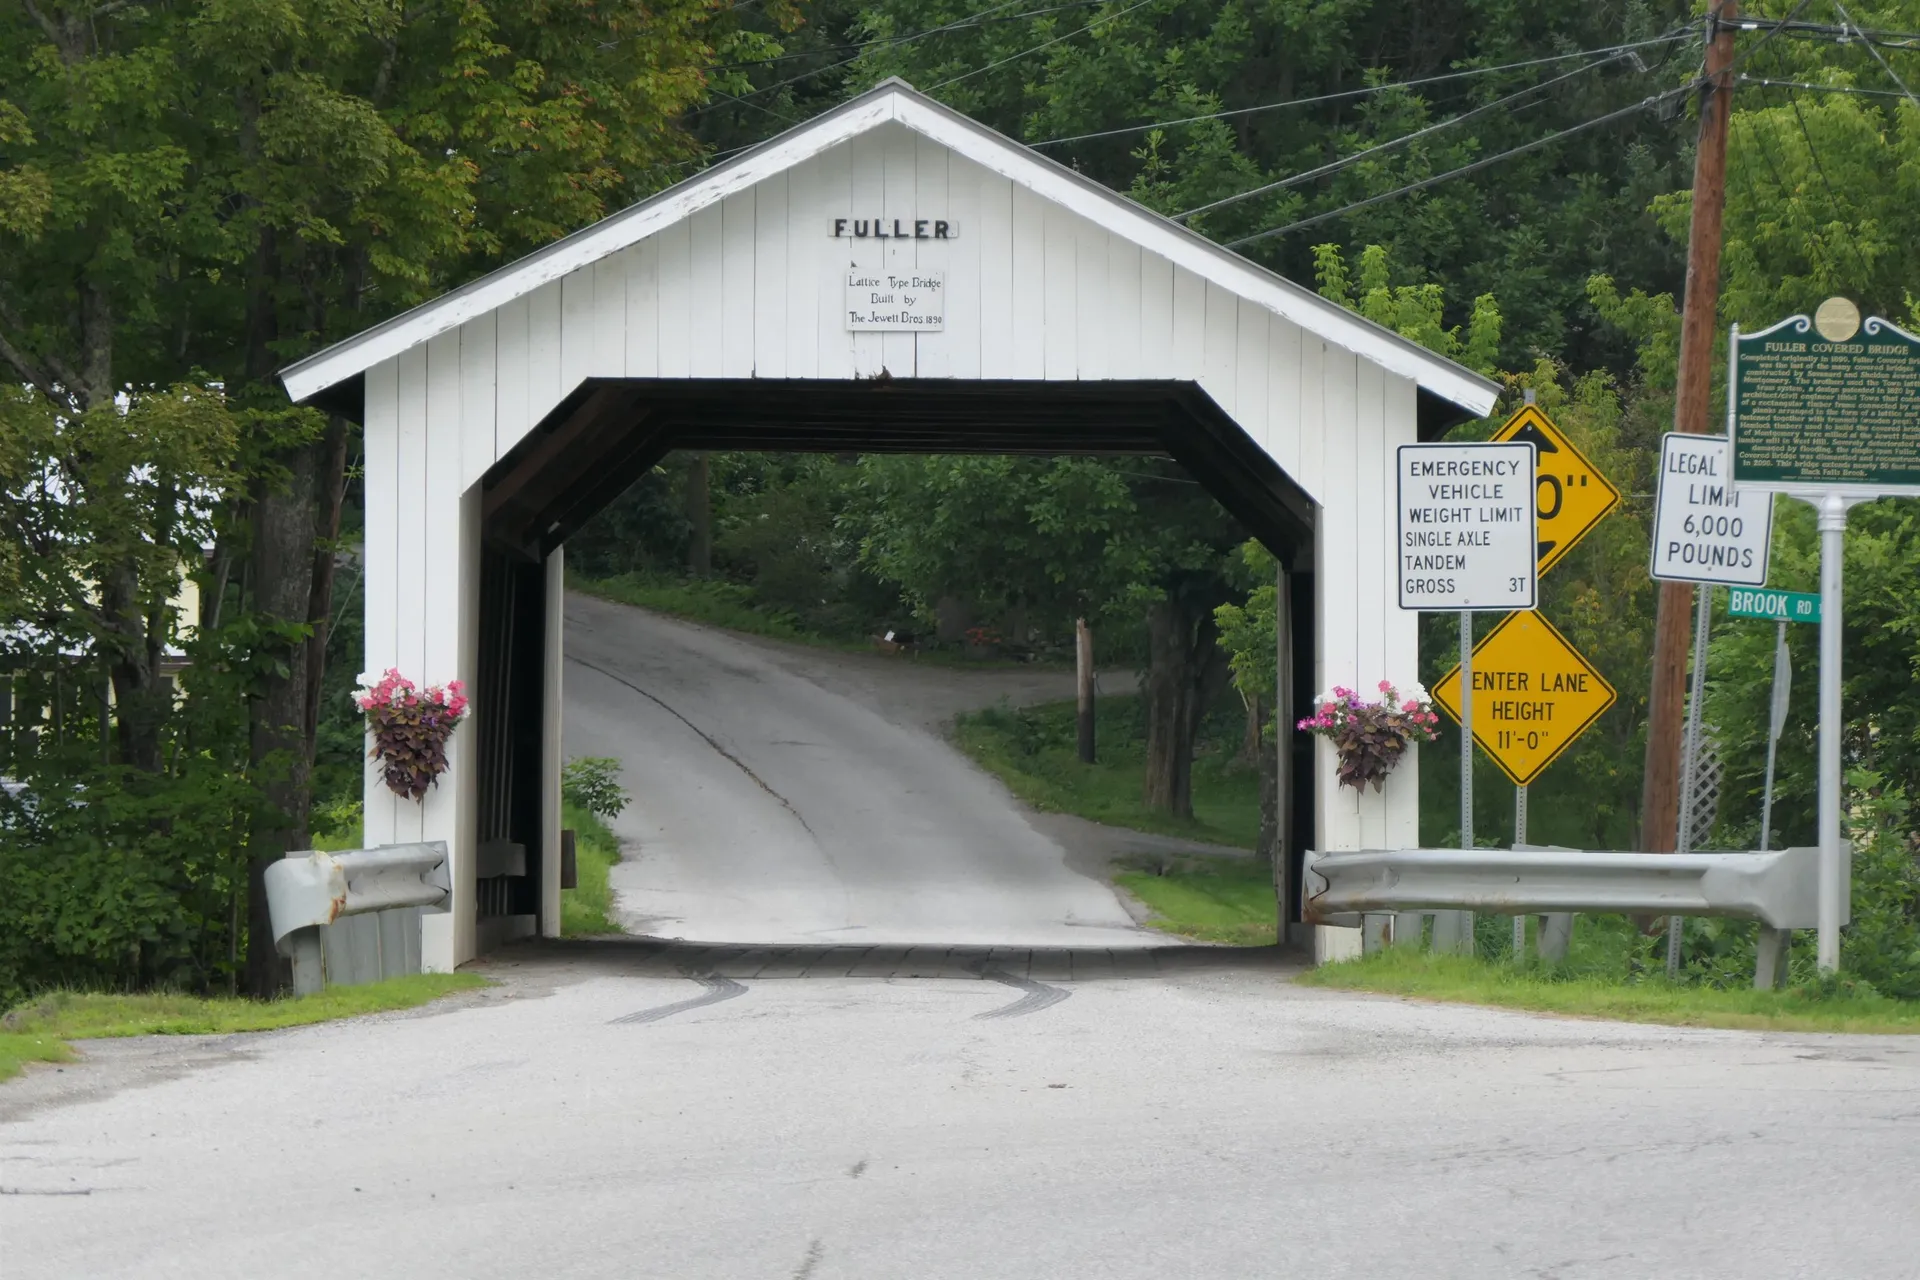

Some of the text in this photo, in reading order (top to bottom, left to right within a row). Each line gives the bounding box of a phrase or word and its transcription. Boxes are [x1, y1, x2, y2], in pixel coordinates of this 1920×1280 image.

[835, 218, 949, 238] FULLER
[848, 276, 941, 292] Lattice Type Bridge
[871, 293, 916, 306] Built by
[849, 312, 865, 323] The
[868, 312, 898, 323] Jewett
[926, 316, 942, 324] 1890
[1765, 342, 1909, 355] FULLER COVERED BRIDGE
[1410, 460, 1520, 476] EMERGENCY
[1669, 452, 1717, 476] LEGAL
[1429, 484, 1504, 500] VEHICLE
[1410, 507, 1522, 523] WEIGHT LIMIT
[1684, 514, 1743, 538] 6,000
[1406, 531, 1490, 547] SINGLE AXLE
[1405, 556, 1466, 570] TANDEM
[1668, 542, 1753, 568] POUNDS
[1406, 577, 1526, 594] GROSS 3T
[1731, 590, 1788, 616] BROOK
[1796, 600, 1812, 614] RD
[1541, 673, 1588, 692] LANE
[1492, 701, 1555, 720] HEIGHT
[1498, 730, 1549, 750] 11'-0"
